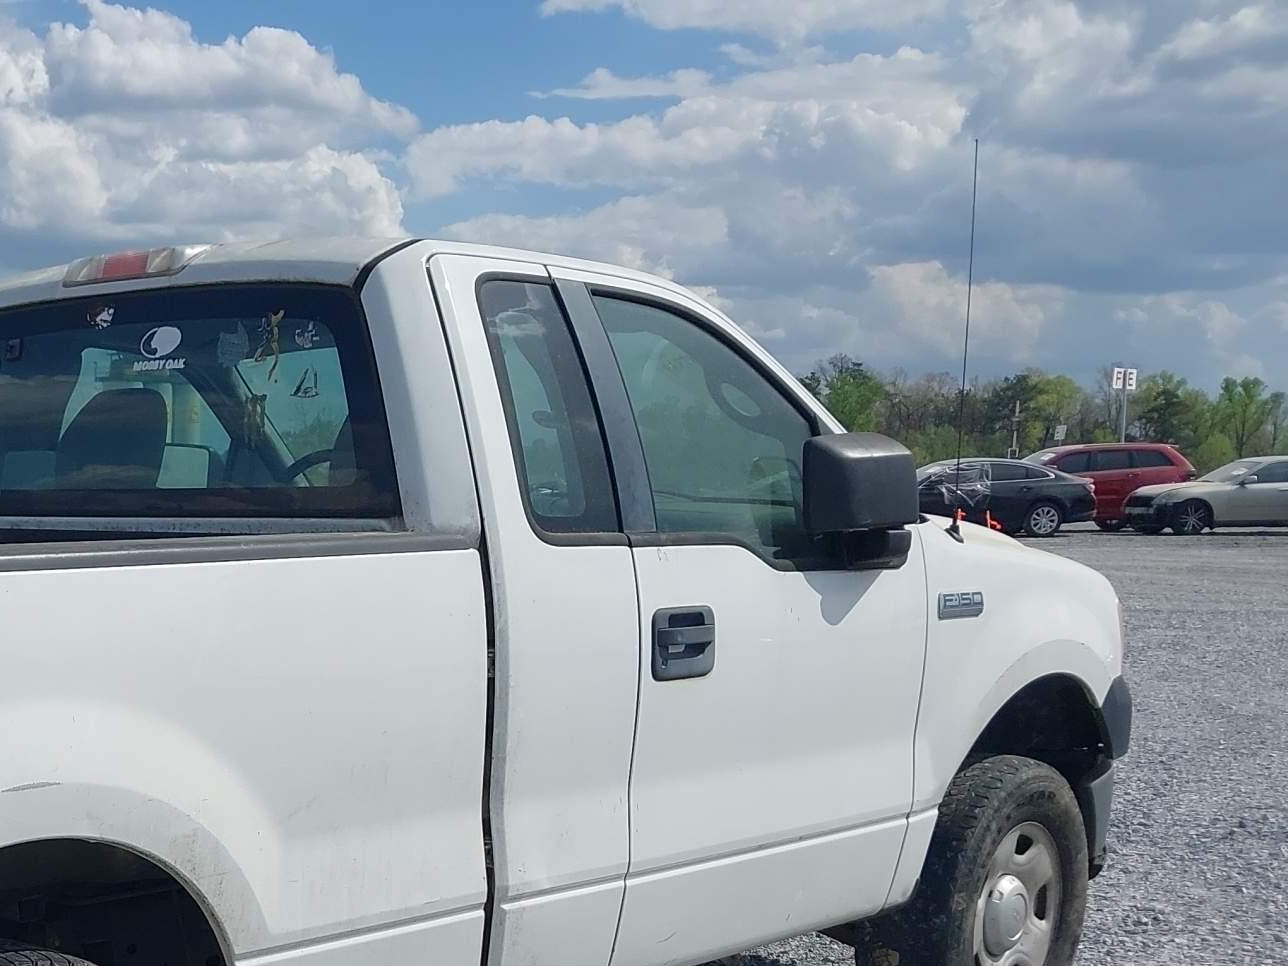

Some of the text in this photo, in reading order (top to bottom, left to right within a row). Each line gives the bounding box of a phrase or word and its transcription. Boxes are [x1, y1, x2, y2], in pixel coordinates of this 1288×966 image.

[133, 358, 186, 371] MOSSY OAK
[1115, 371, 1123, 387] F
[1127, 371, 1135, 387] E
